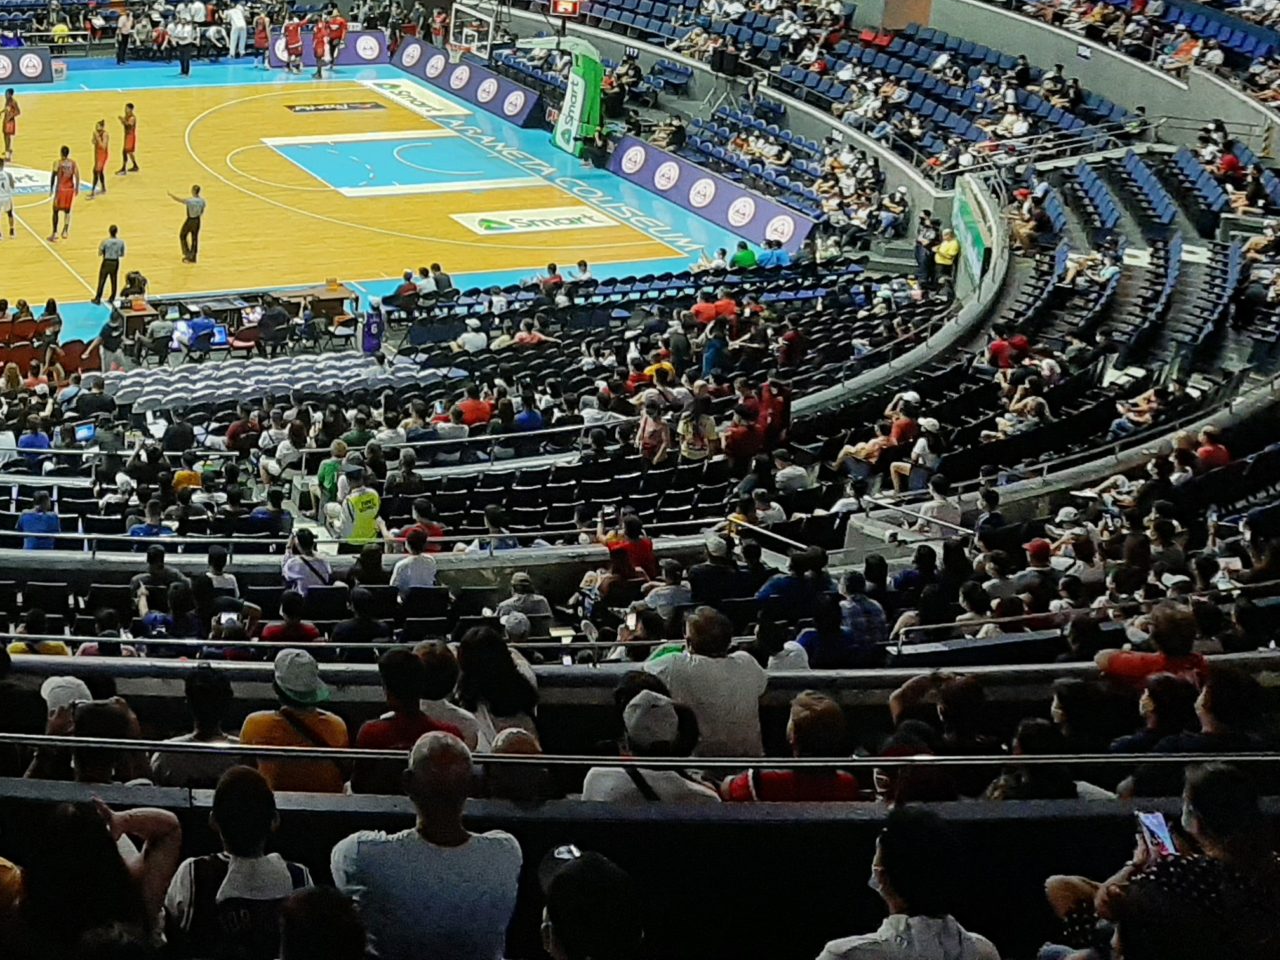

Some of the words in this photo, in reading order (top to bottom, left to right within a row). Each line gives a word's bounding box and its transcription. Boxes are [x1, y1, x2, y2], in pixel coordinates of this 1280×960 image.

[564, 80, 579, 127] Smart
[435, 117, 558, 177] ARANETA
[554, 176, 705, 252] COLISEUM
[508, 213, 605, 228] Smart
[370, 323, 379, 335] 6
